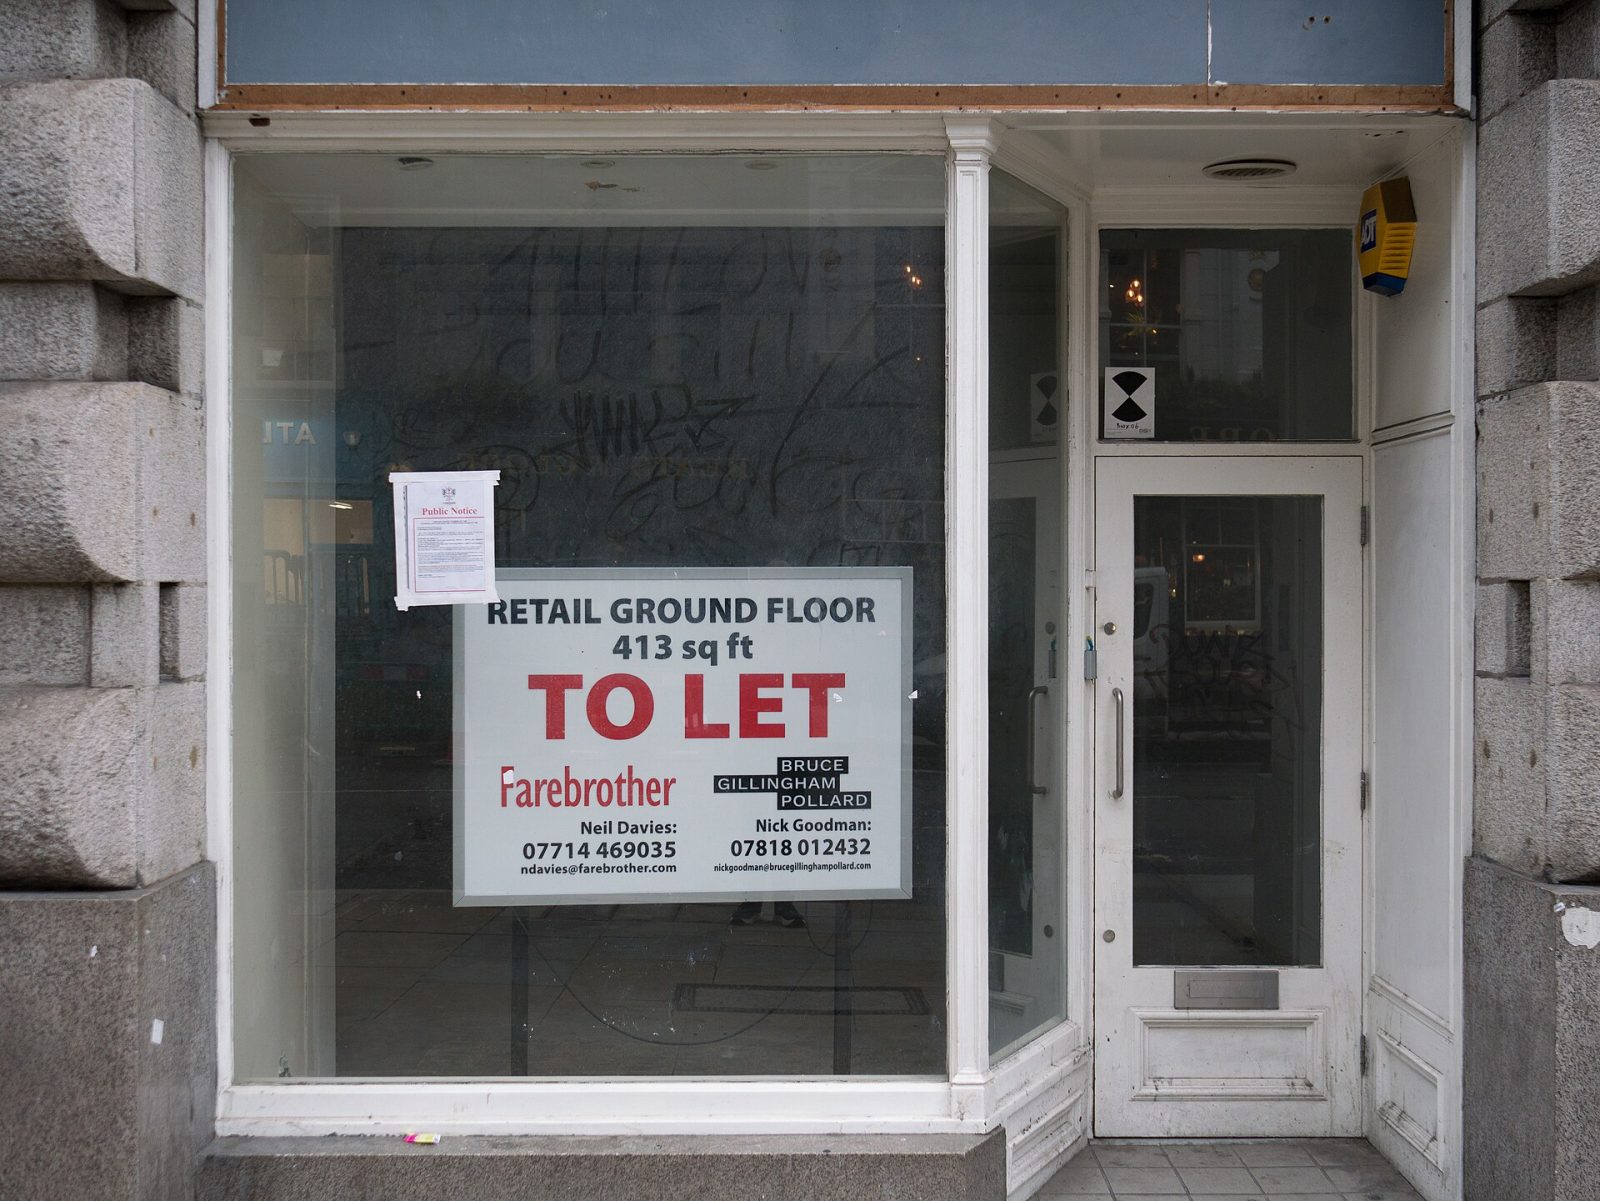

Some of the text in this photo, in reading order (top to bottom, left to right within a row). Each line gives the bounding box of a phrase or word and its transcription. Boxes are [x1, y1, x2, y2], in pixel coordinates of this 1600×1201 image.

[1360, 216, 1376, 247] ADT
[451, 507, 477, 515] Notice
[488, 597, 875, 624] RETAIL GROUND FLOOR
[613, 632, 753, 666] 413 sq ft
[528, 674, 845, 740] TO LET
[782, 759, 844, 772] BRUCE
[502, 766, 675, 807] Farebrother
[718, 777, 836, 790] GILLINGHAM
[782, 794, 868, 807] POLLARD
[581, 820, 676, 834] Neil Davies:
[757, 818, 871, 832] Nick Goodman:
[523, 842, 675, 859] 07714 469035
[731, 838, 870, 856] 07818 012432
[521, 862, 676, 875] ndavies@farebrother.com
[714, 861, 871, 874] nickgoodman@brucegillinghampollard.com
